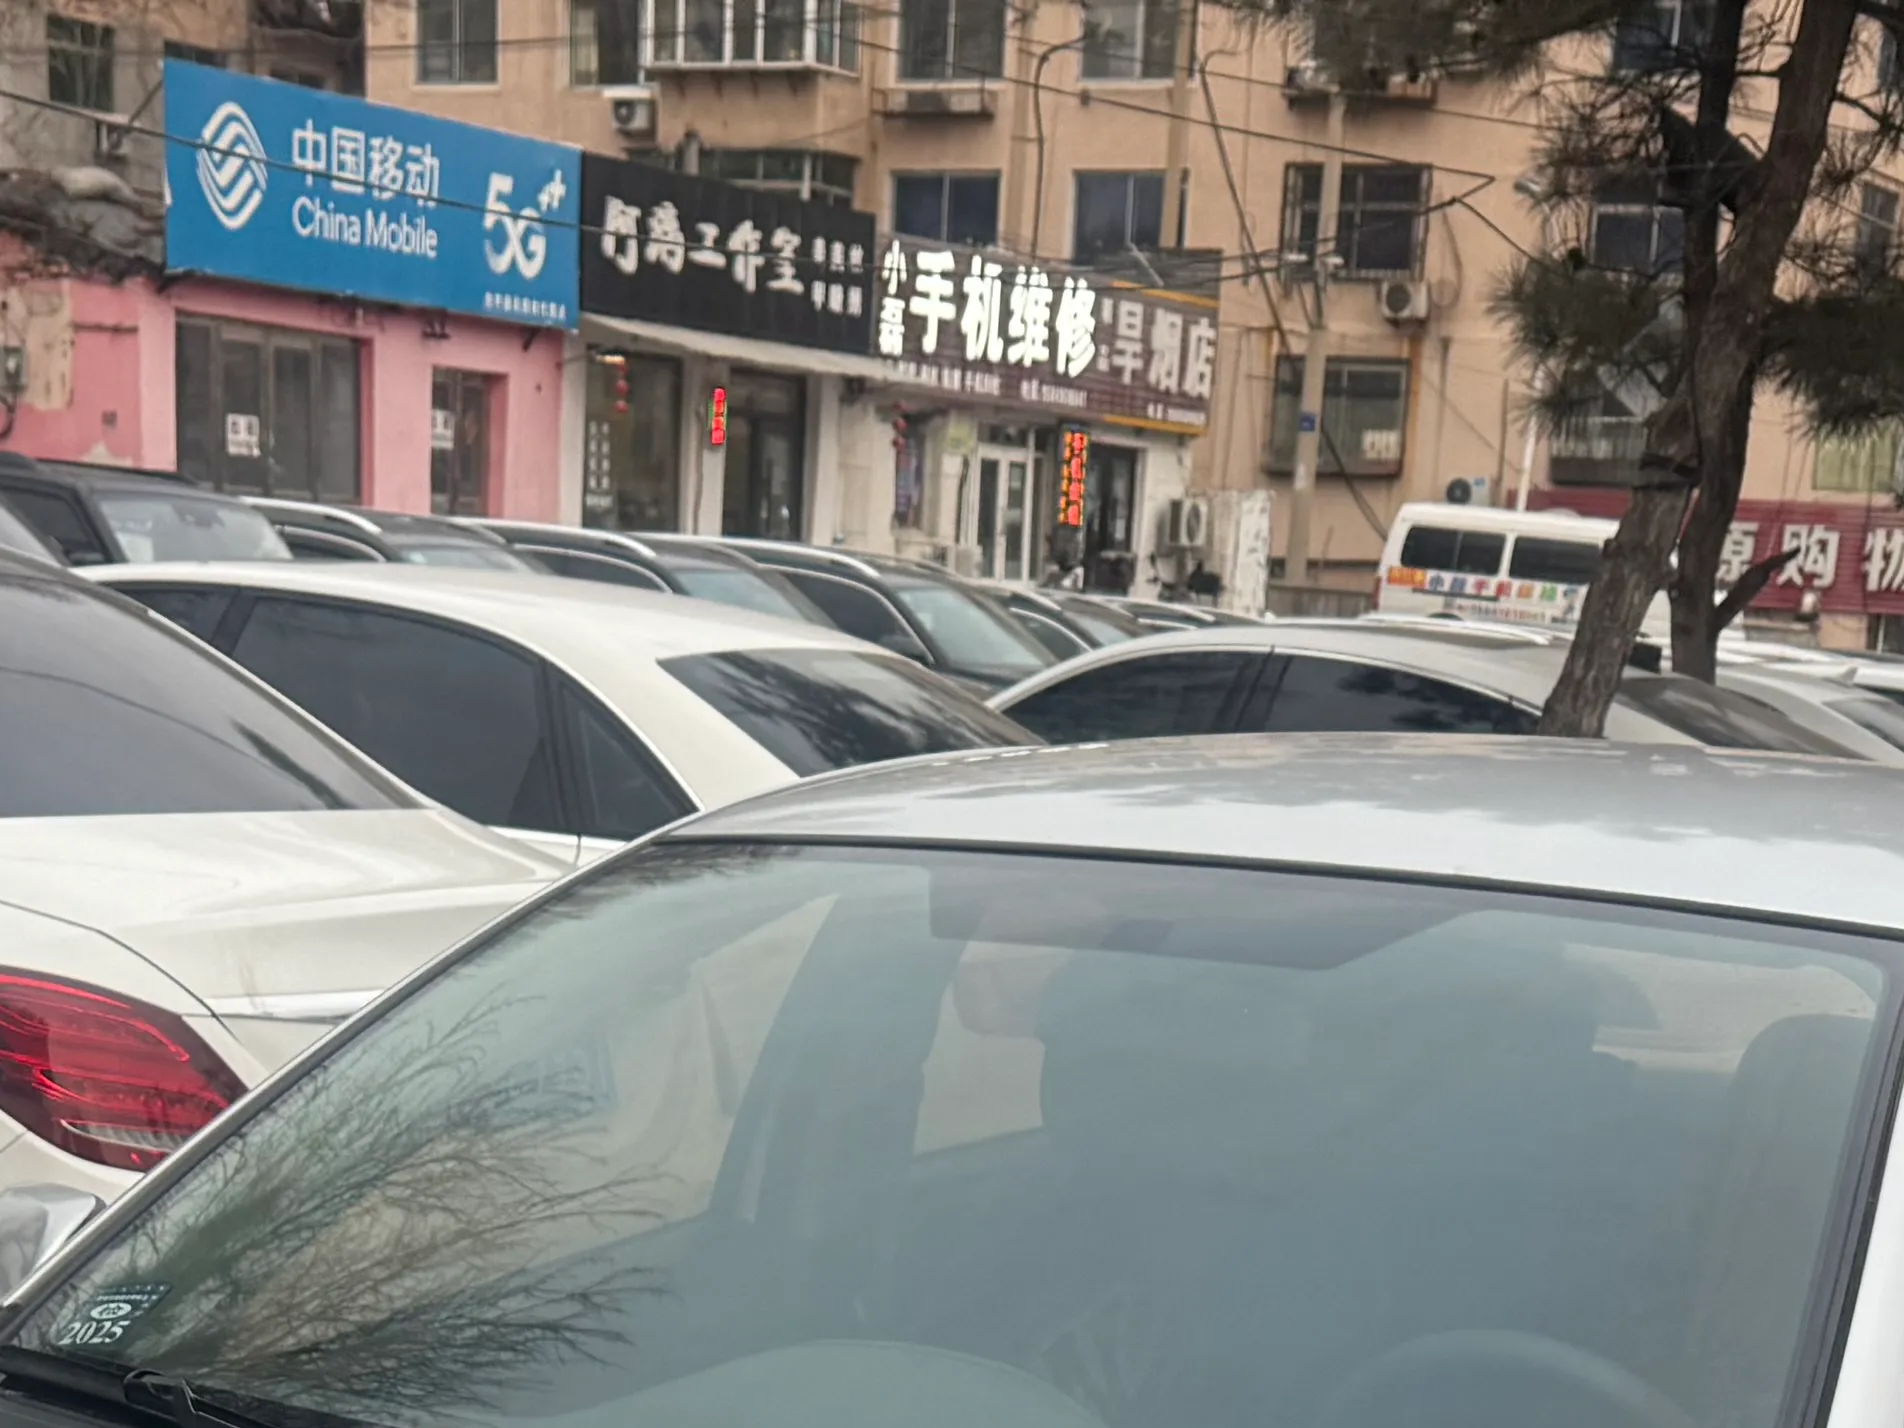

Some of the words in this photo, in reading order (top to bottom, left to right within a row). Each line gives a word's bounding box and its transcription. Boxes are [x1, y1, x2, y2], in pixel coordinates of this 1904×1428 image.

[292, 118, 440, 208] 中国移动
[292, 196, 361, 245] China
[365, 208, 438, 259] Mobile
[909, 250, 1095, 378] 手机维修
[58, 1320, 130, 1345] 2025
